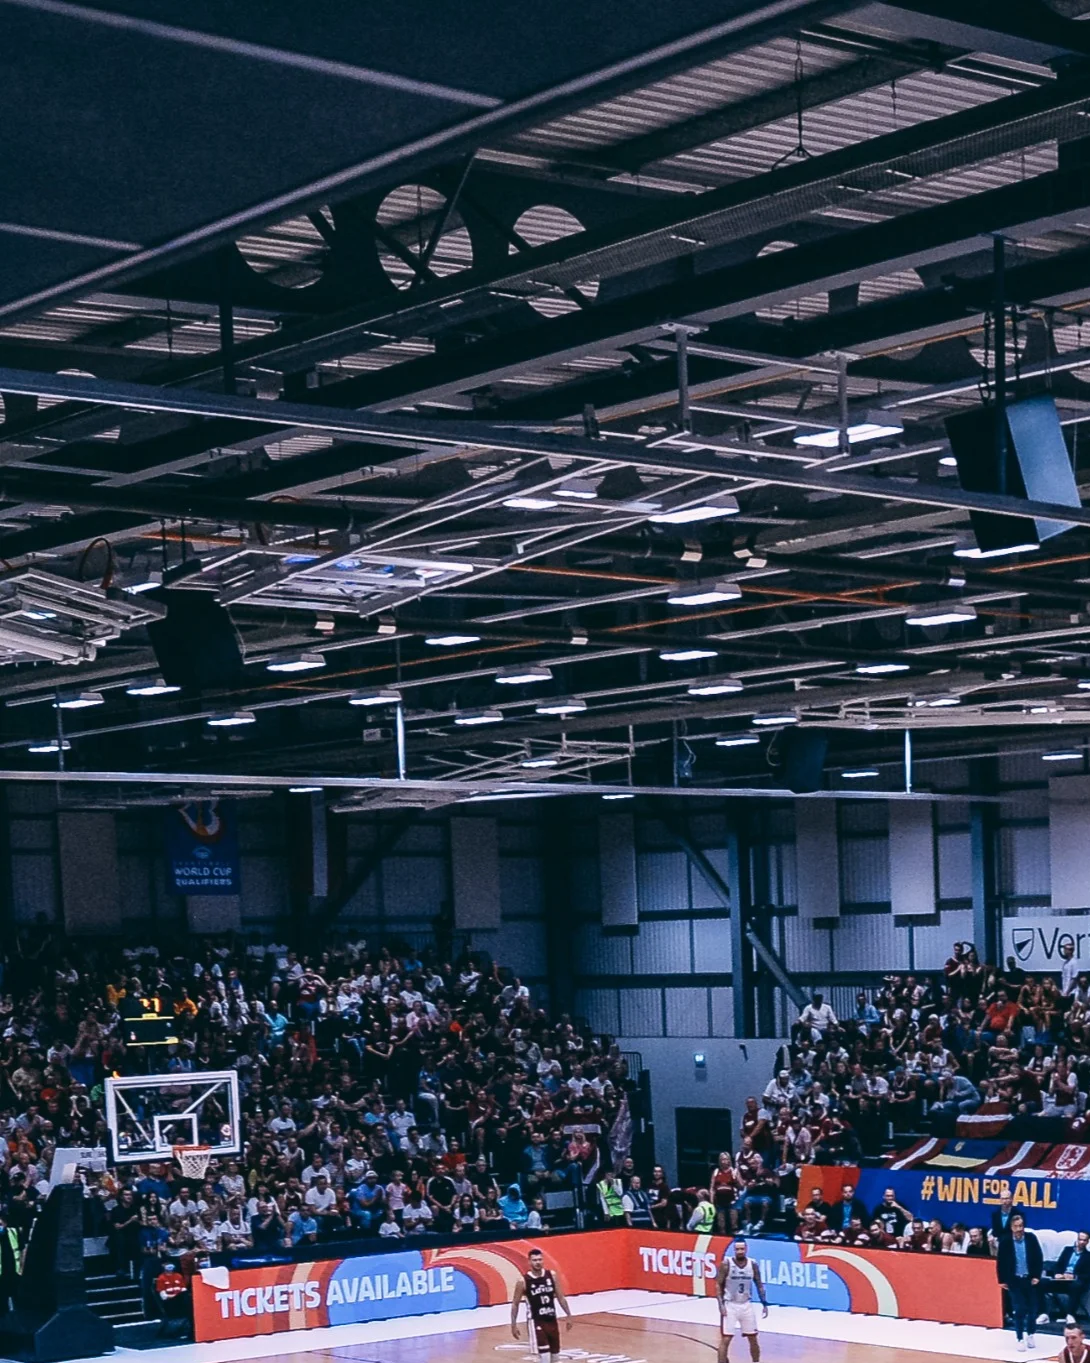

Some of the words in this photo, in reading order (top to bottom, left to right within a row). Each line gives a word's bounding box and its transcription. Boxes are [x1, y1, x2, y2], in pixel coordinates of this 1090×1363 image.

[921, 1175, 979, 1205] #WIN
[1012, 1181, 1057, 1209] ALL
[639, 1246, 717, 1279] TICKETS
[215, 1281, 320, 1319] TICKETS
[326, 1266, 454, 1306] AVAILABLE
